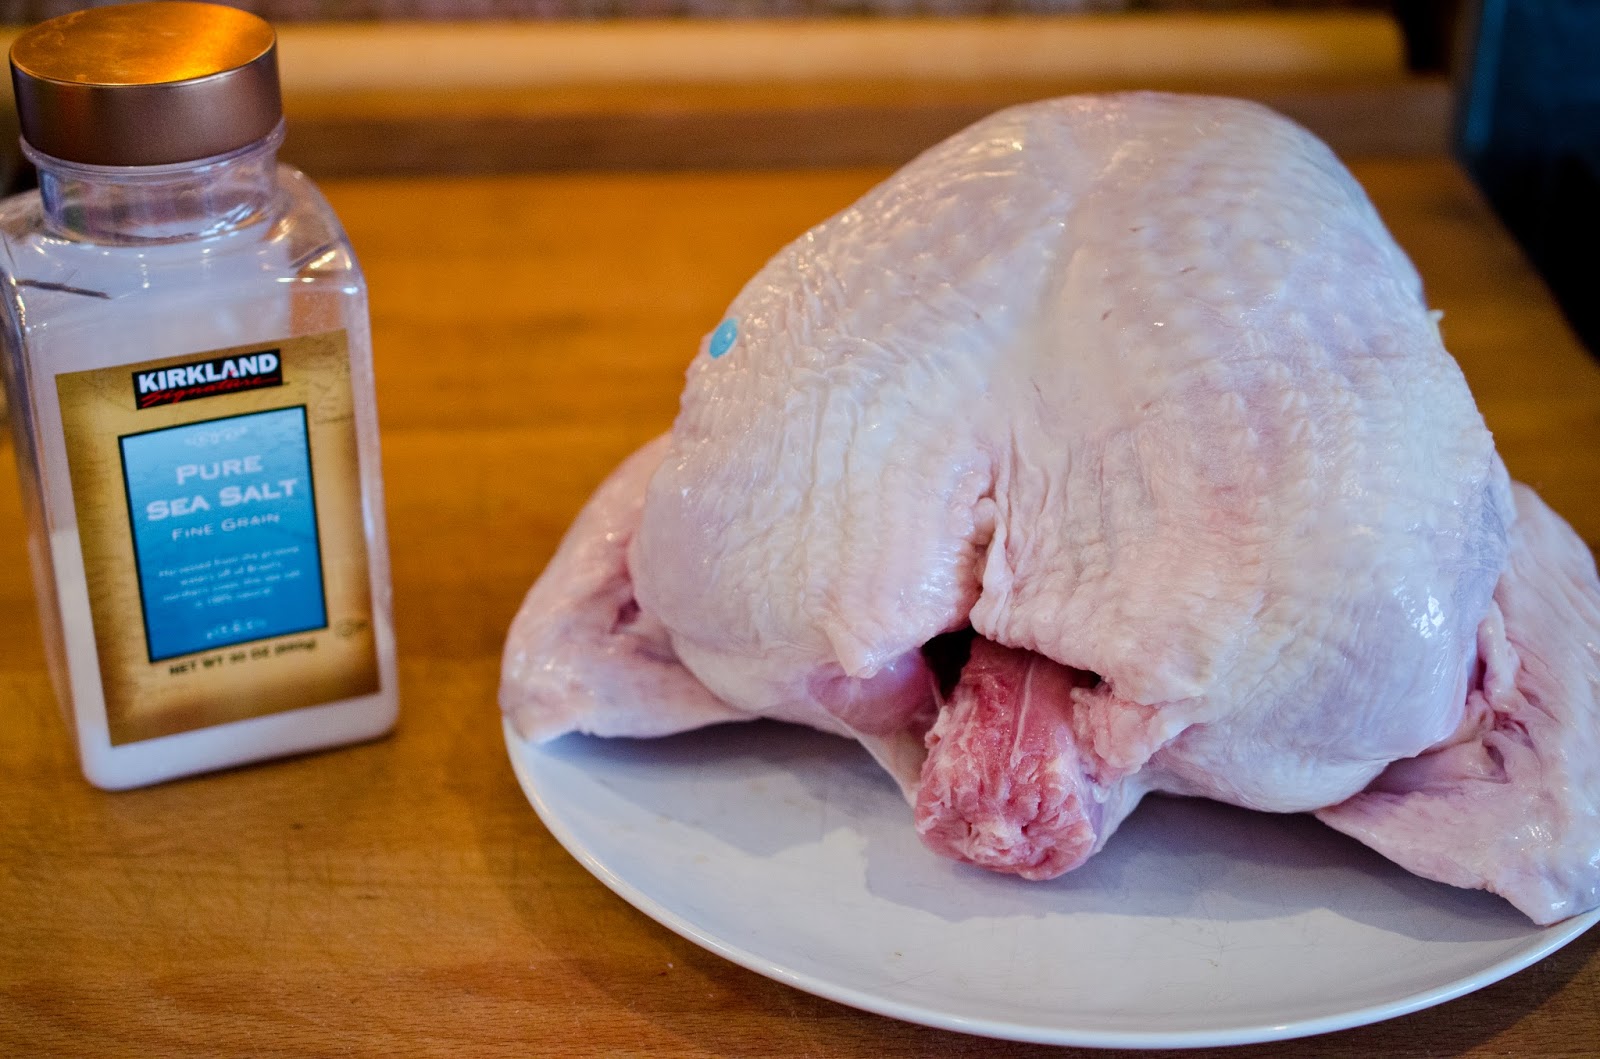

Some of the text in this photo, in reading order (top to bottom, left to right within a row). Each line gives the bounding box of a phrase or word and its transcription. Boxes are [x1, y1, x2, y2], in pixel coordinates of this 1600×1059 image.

[138, 353, 278, 394] KIRKLAND
[140, 376, 279, 408] Signature
[176, 455, 263, 486] PURE
[147, 478, 298, 521] SEA SALT
[172, 523, 215, 541] FINE
